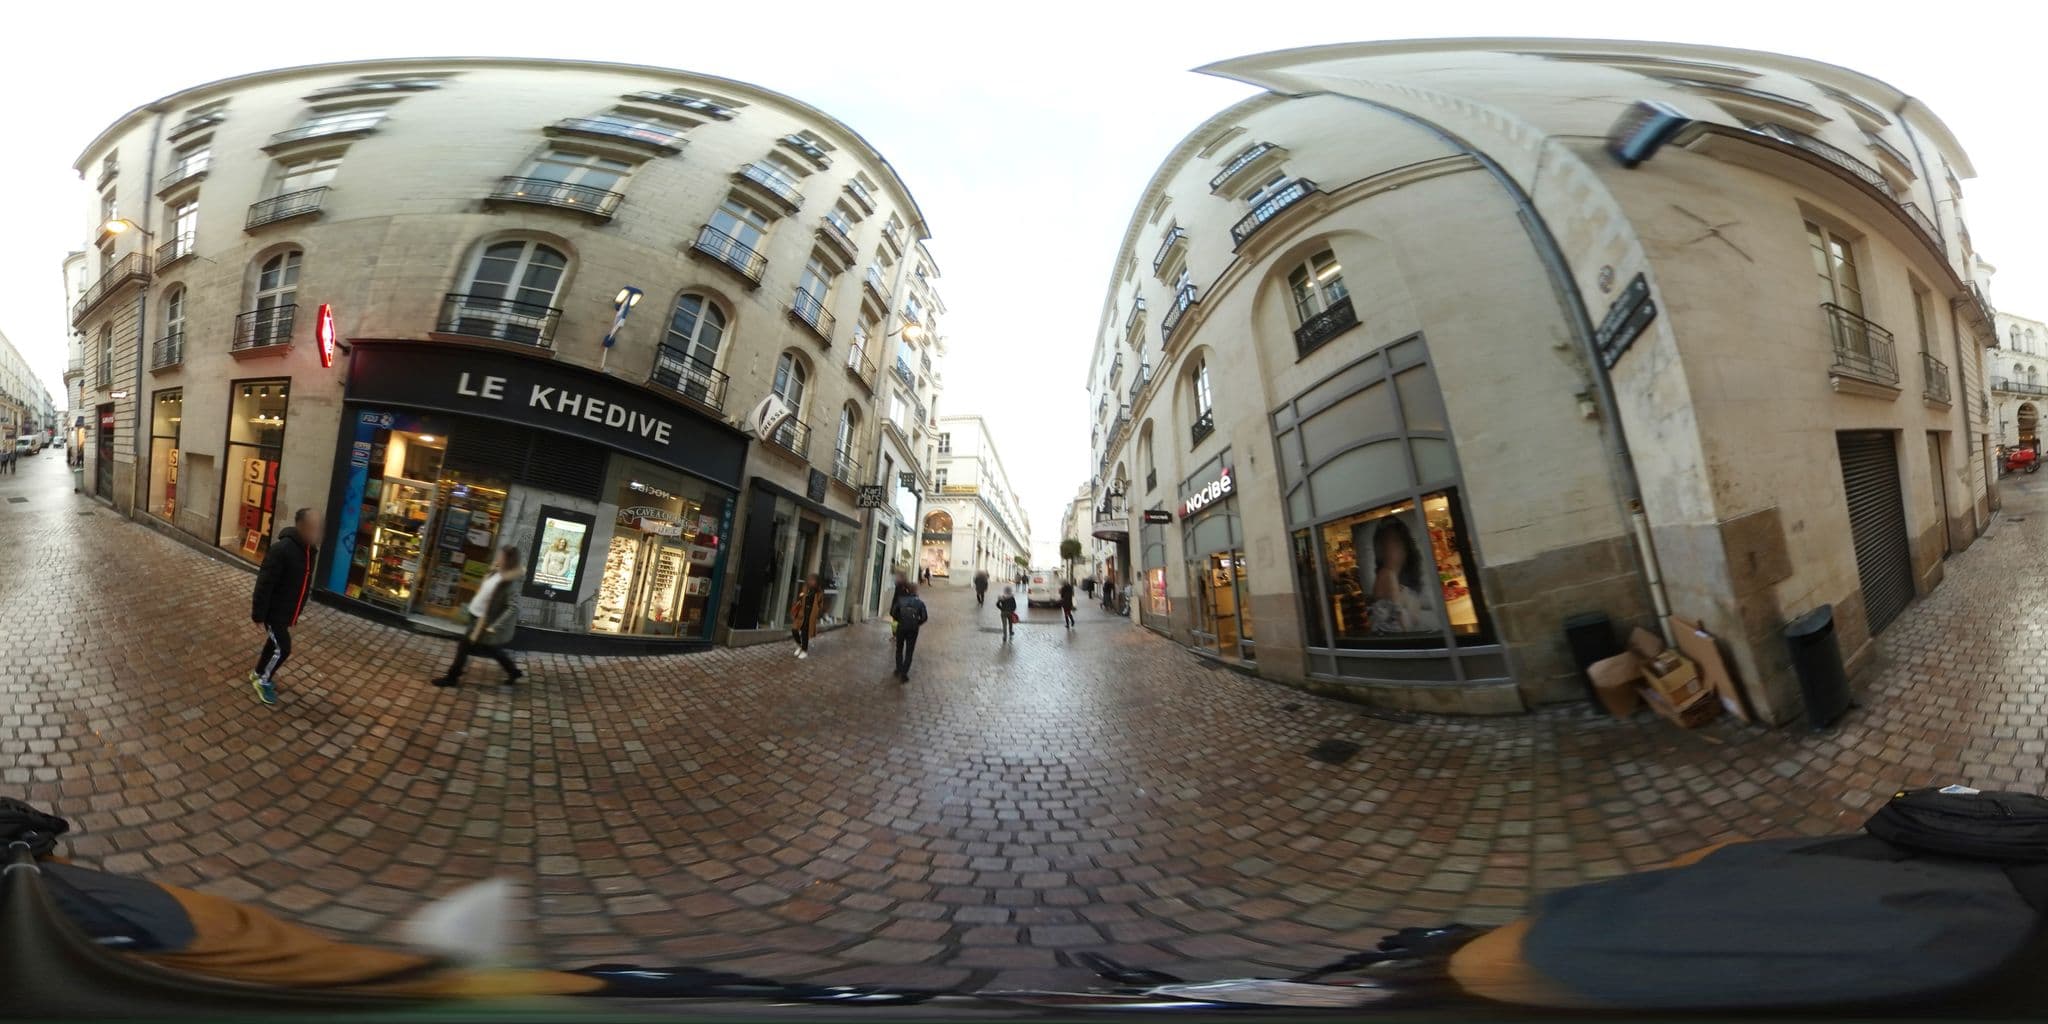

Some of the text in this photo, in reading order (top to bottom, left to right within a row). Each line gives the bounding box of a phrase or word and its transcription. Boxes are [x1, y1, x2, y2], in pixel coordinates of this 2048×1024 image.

[457, 372, 673, 446] LE KHEDIVE
[363, 414, 379, 423] FDJ
[760, 410, 784, 436] PRESSE
[864, 487, 881, 497] Karl
[861, 499, 881, 507] John
[636, 508, 656, 517] CAVE
